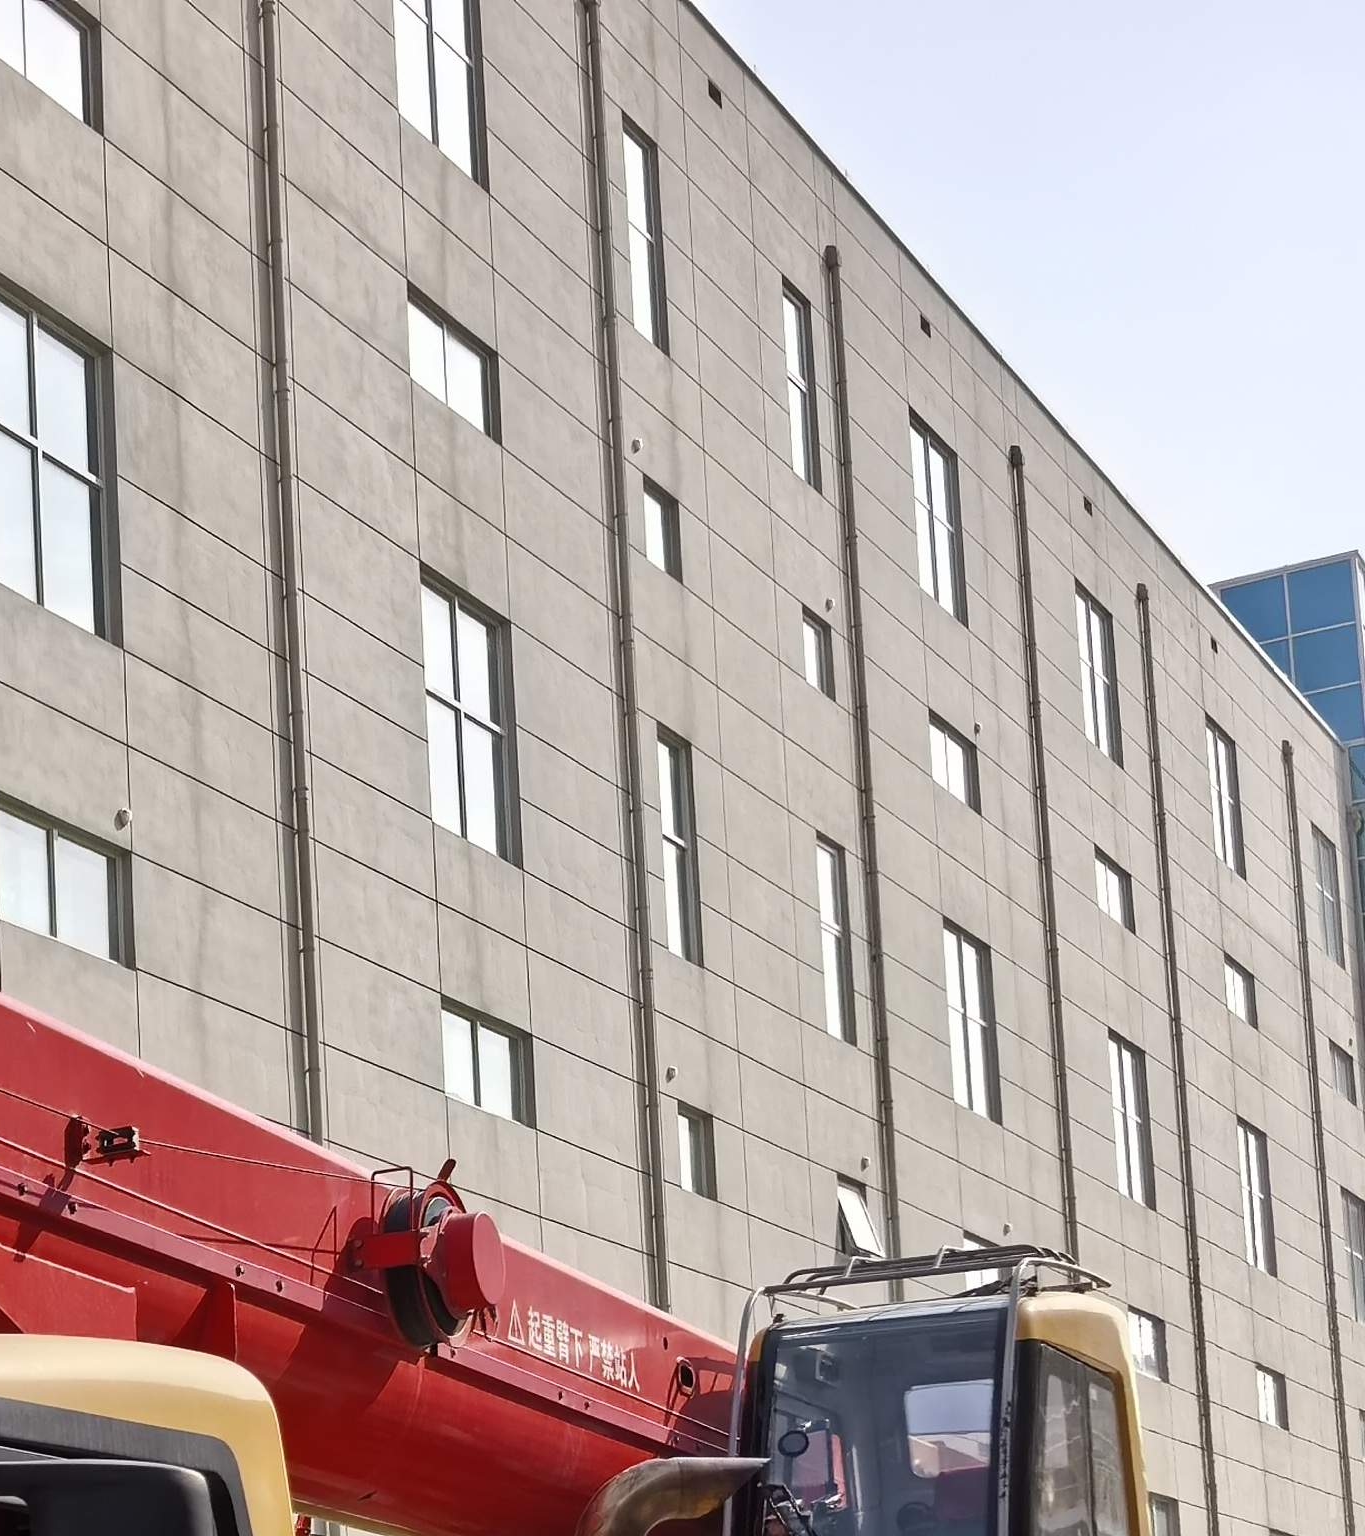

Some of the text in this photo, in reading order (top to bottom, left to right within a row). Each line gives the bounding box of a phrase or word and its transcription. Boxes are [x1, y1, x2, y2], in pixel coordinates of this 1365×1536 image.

[527, 1305, 640, 1393] 起重臂下 严禁站人
